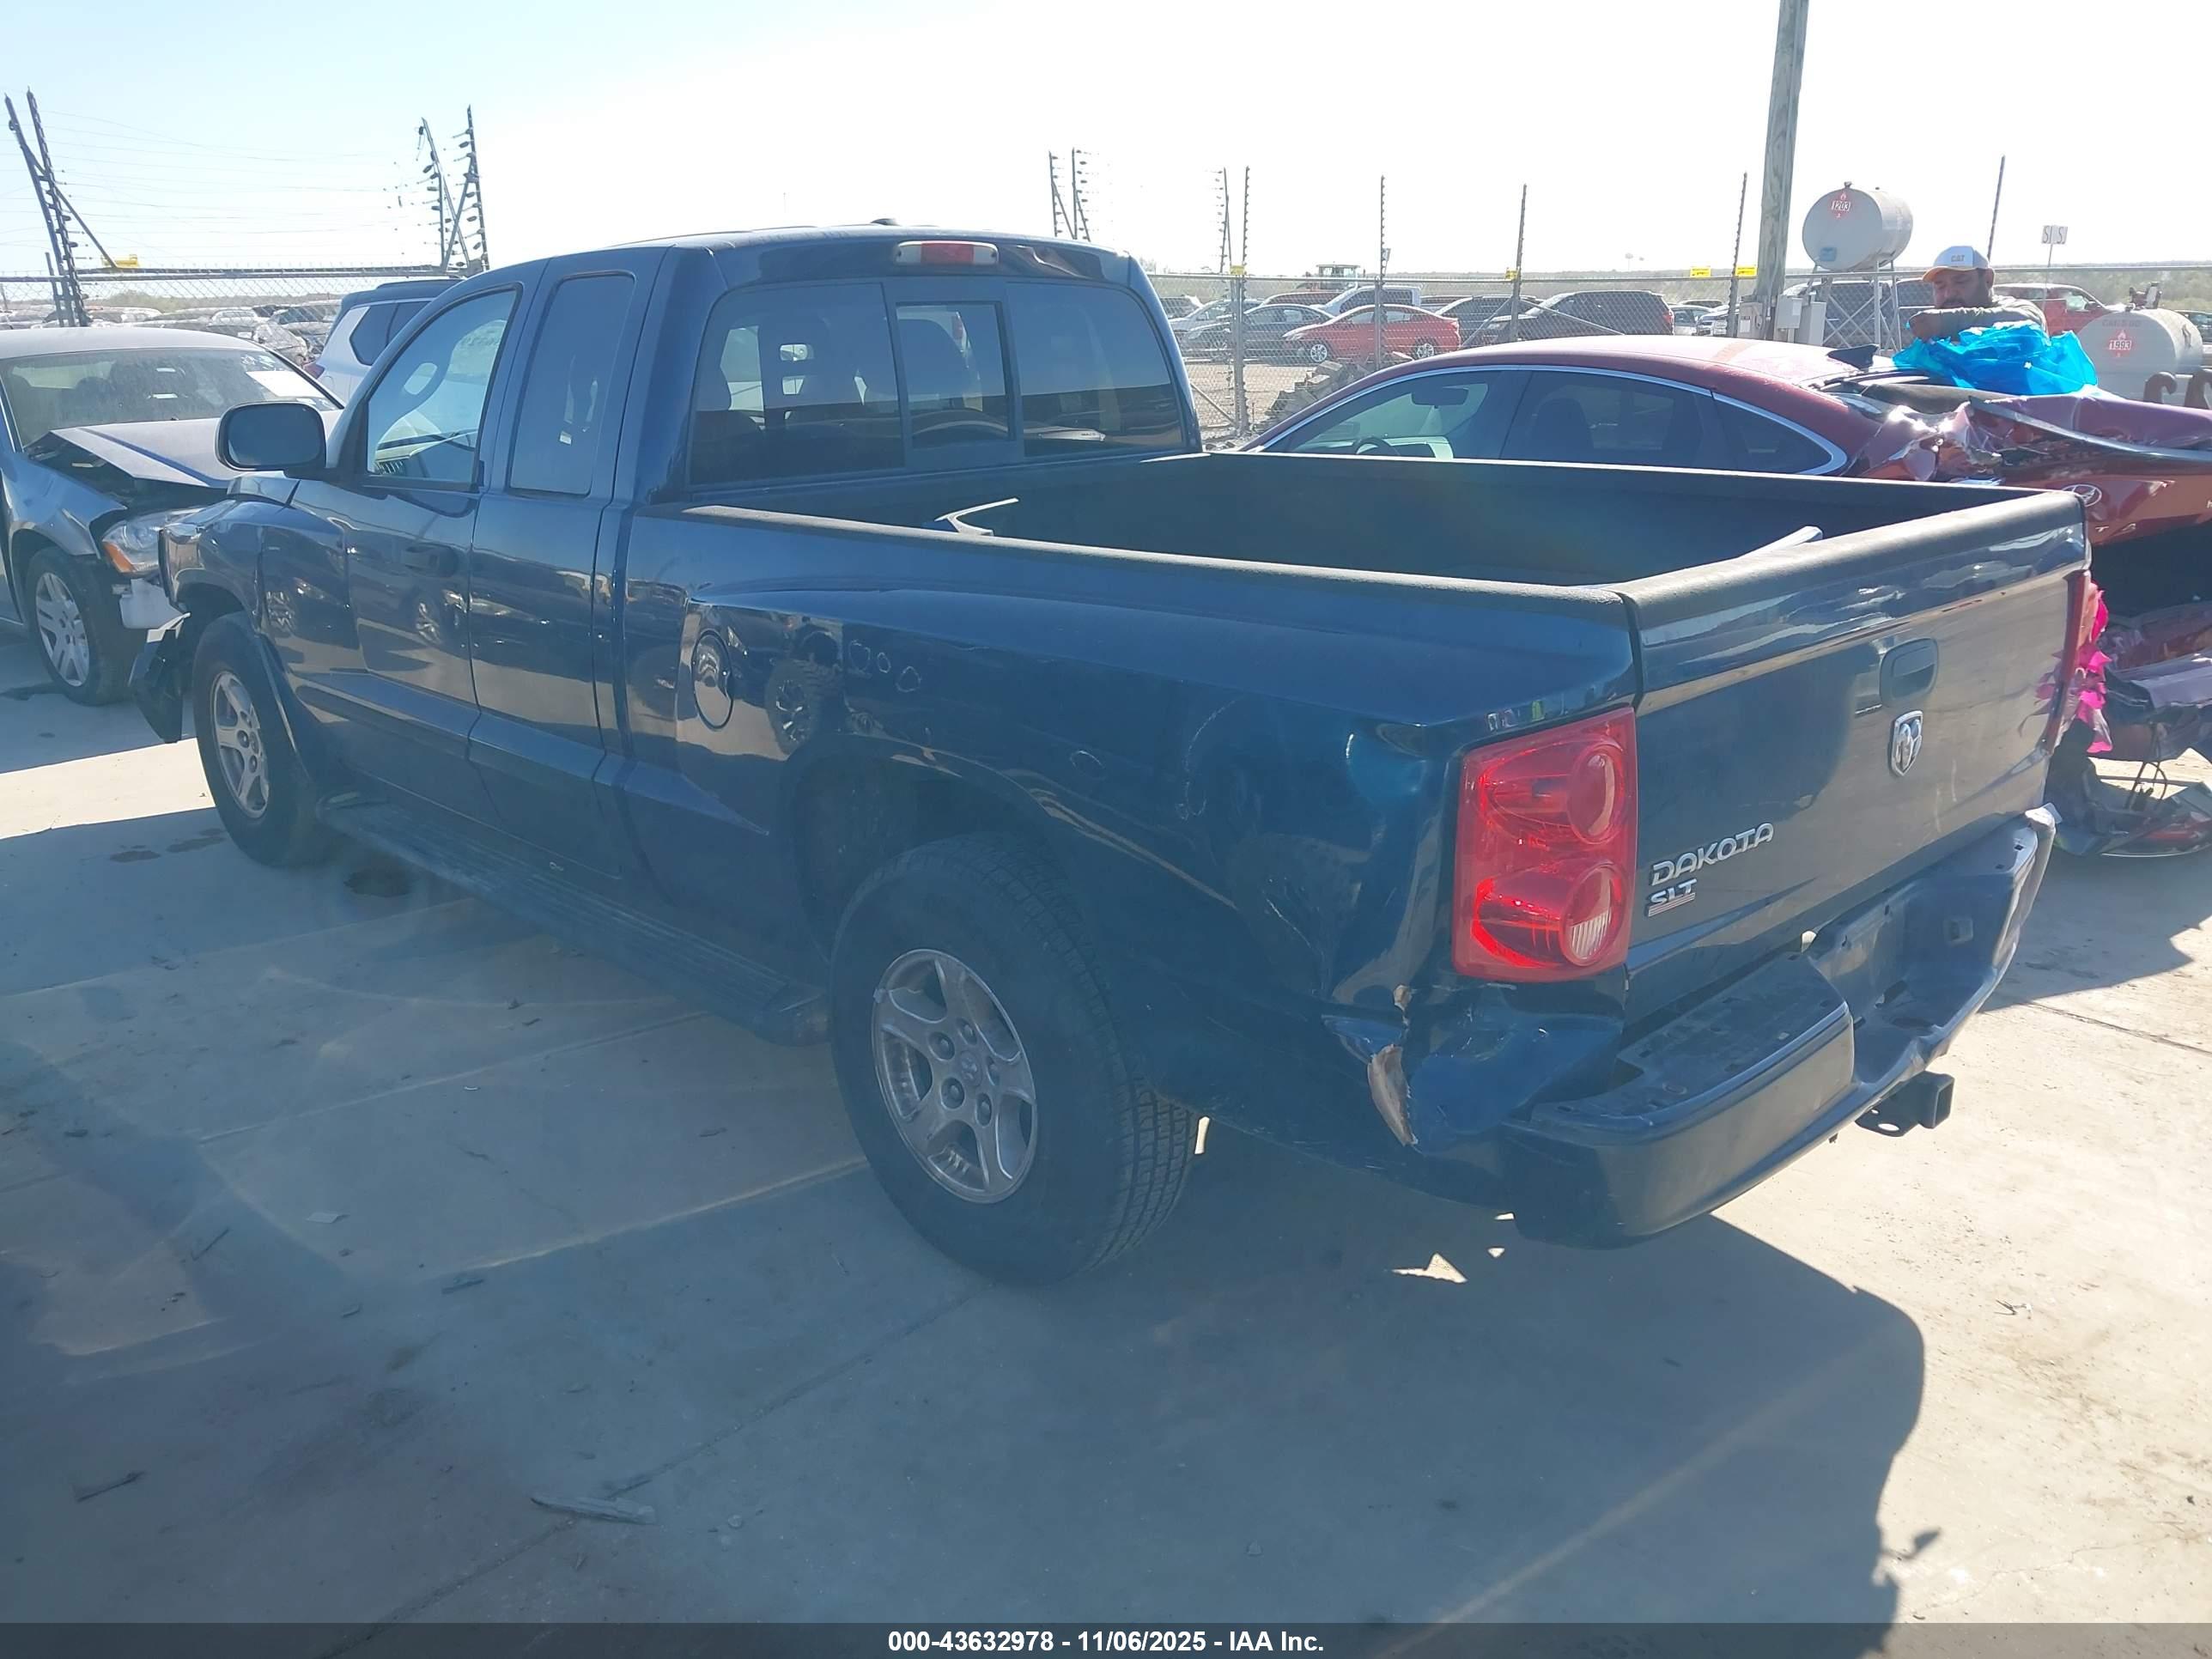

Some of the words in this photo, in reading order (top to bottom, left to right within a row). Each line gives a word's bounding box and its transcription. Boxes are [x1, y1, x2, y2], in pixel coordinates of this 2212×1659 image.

[1833, 201, 1850, 210] 1203
[2111, 340, 2131, 349] 1993
[1651, 823, 1774, 885] DAKOTA
[1650, 878, 1697, 904] SLT
